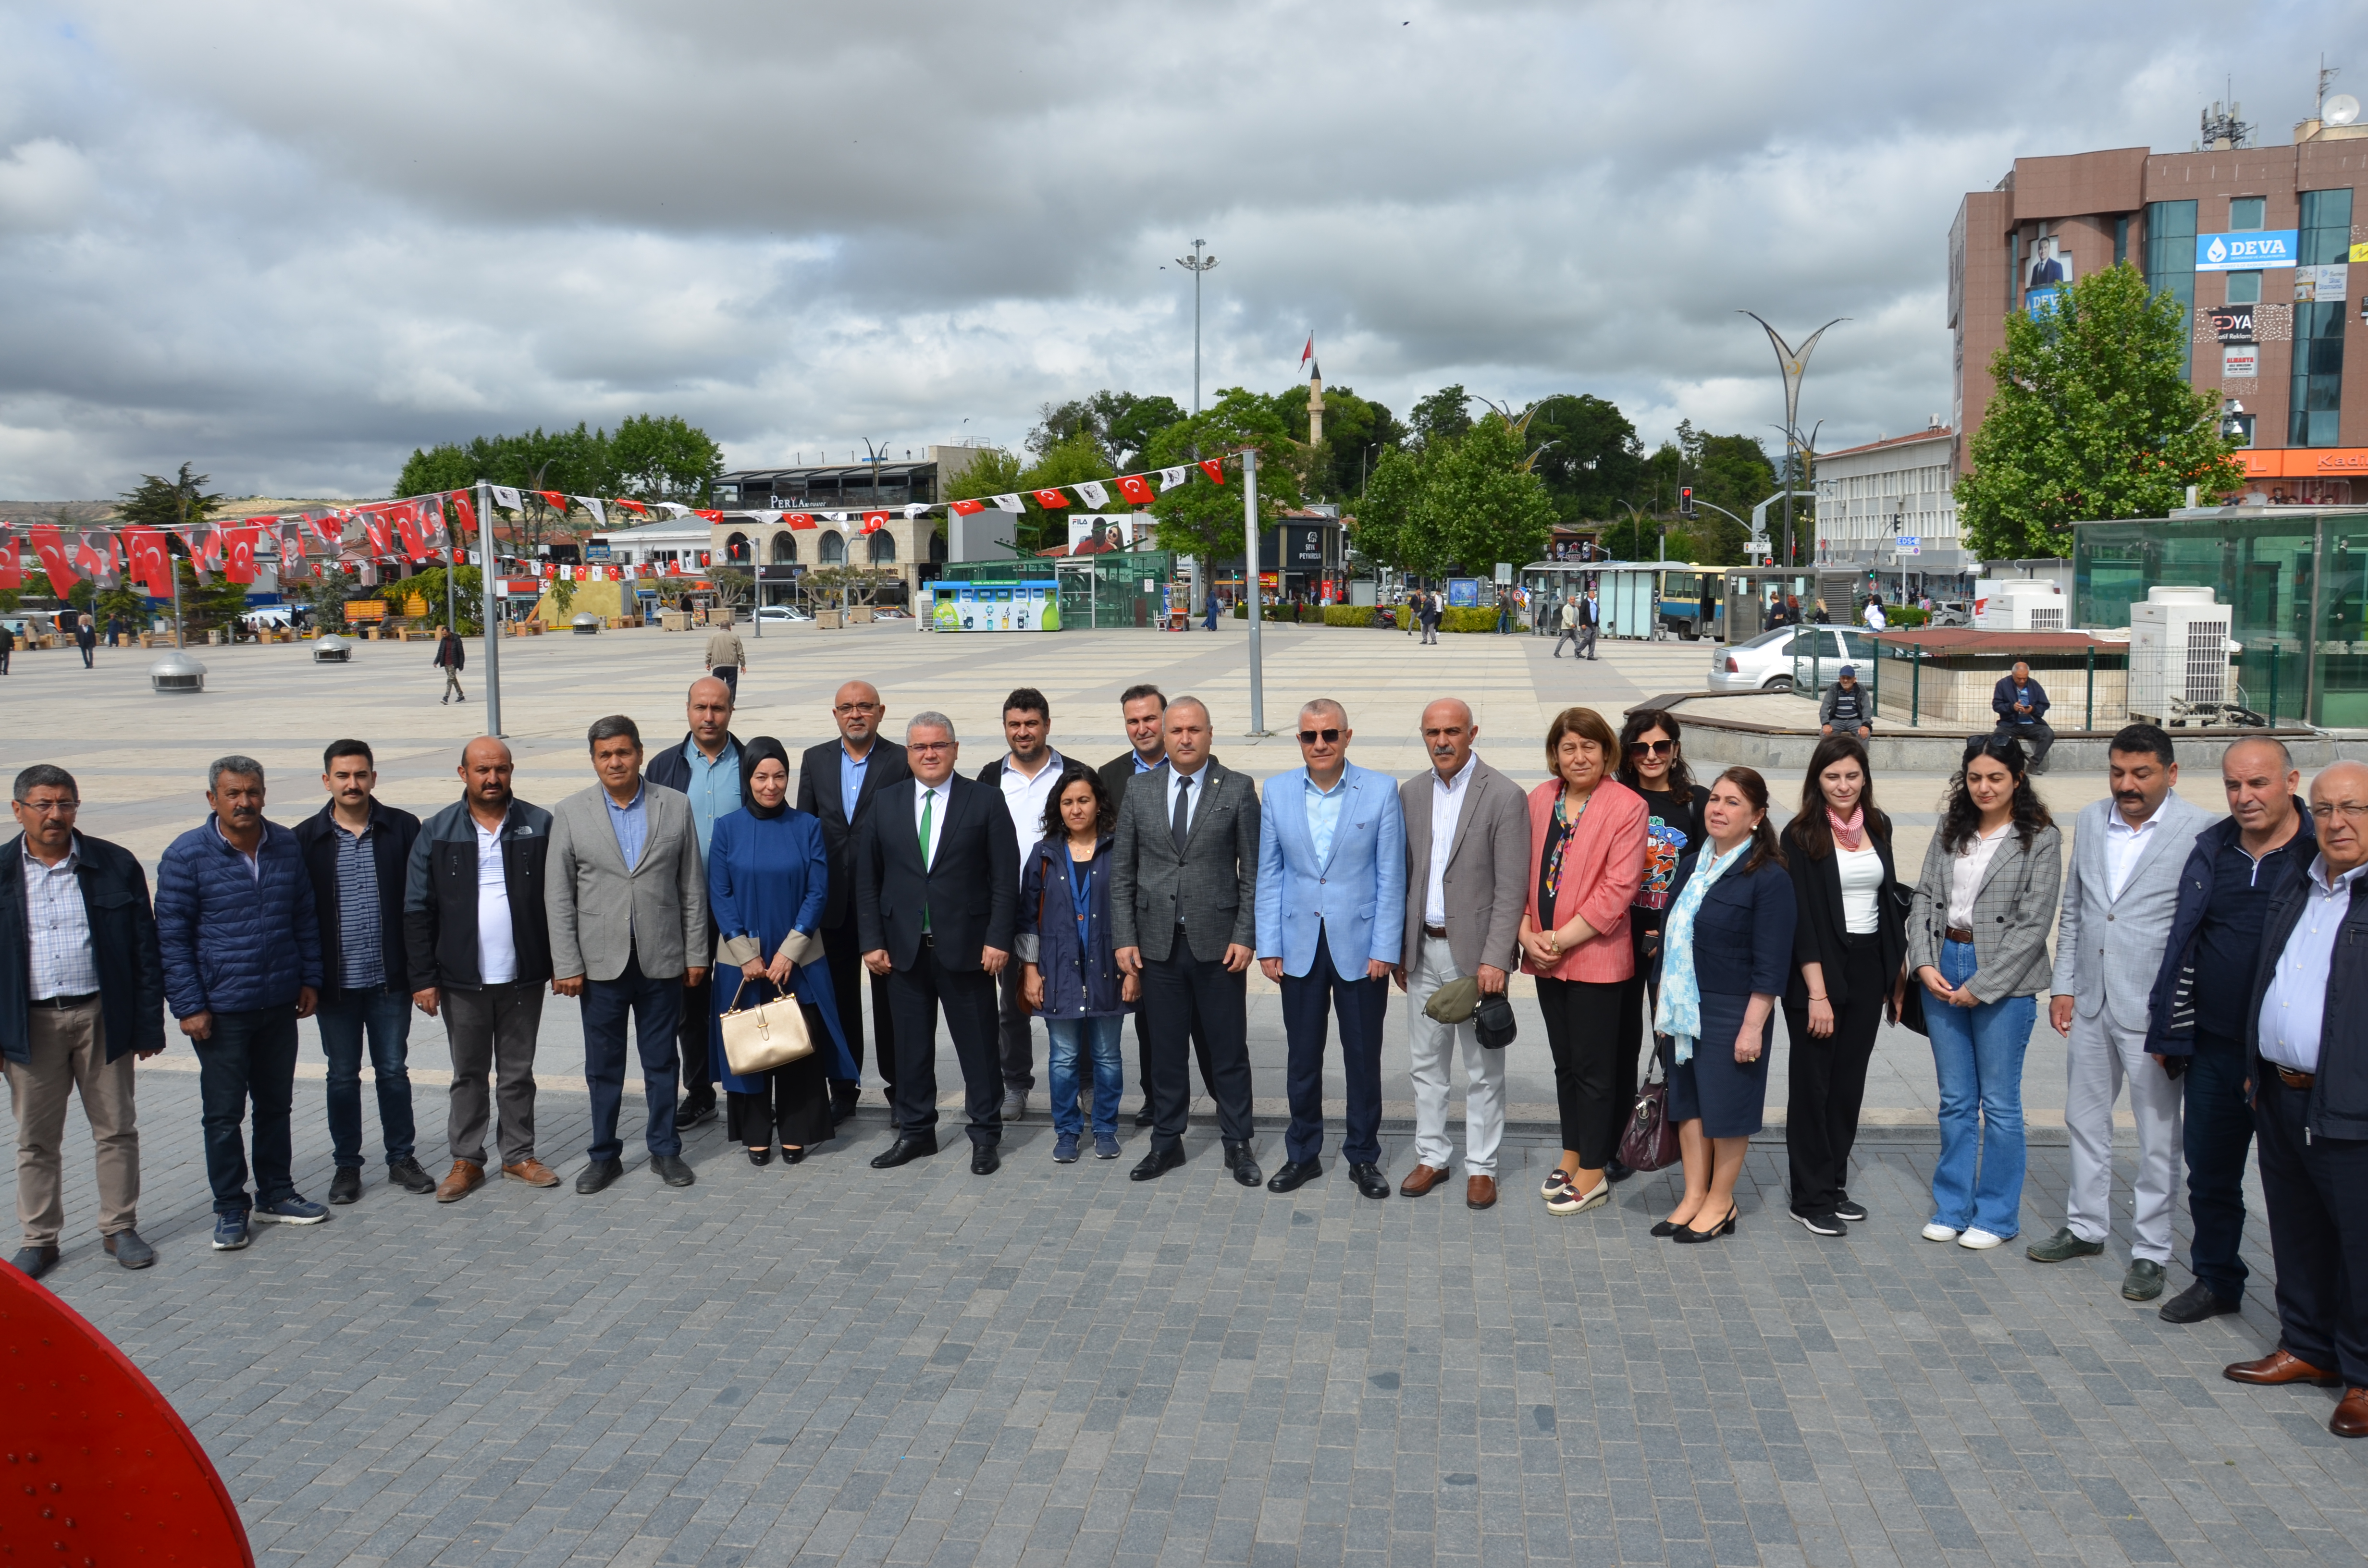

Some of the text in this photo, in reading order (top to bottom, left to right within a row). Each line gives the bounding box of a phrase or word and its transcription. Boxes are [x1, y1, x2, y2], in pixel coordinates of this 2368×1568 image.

[2231, 240, 2286, 256] DEVA
[2033, 294, 2060, 308] DEV
[770, 495, 805, 508] PERLA
